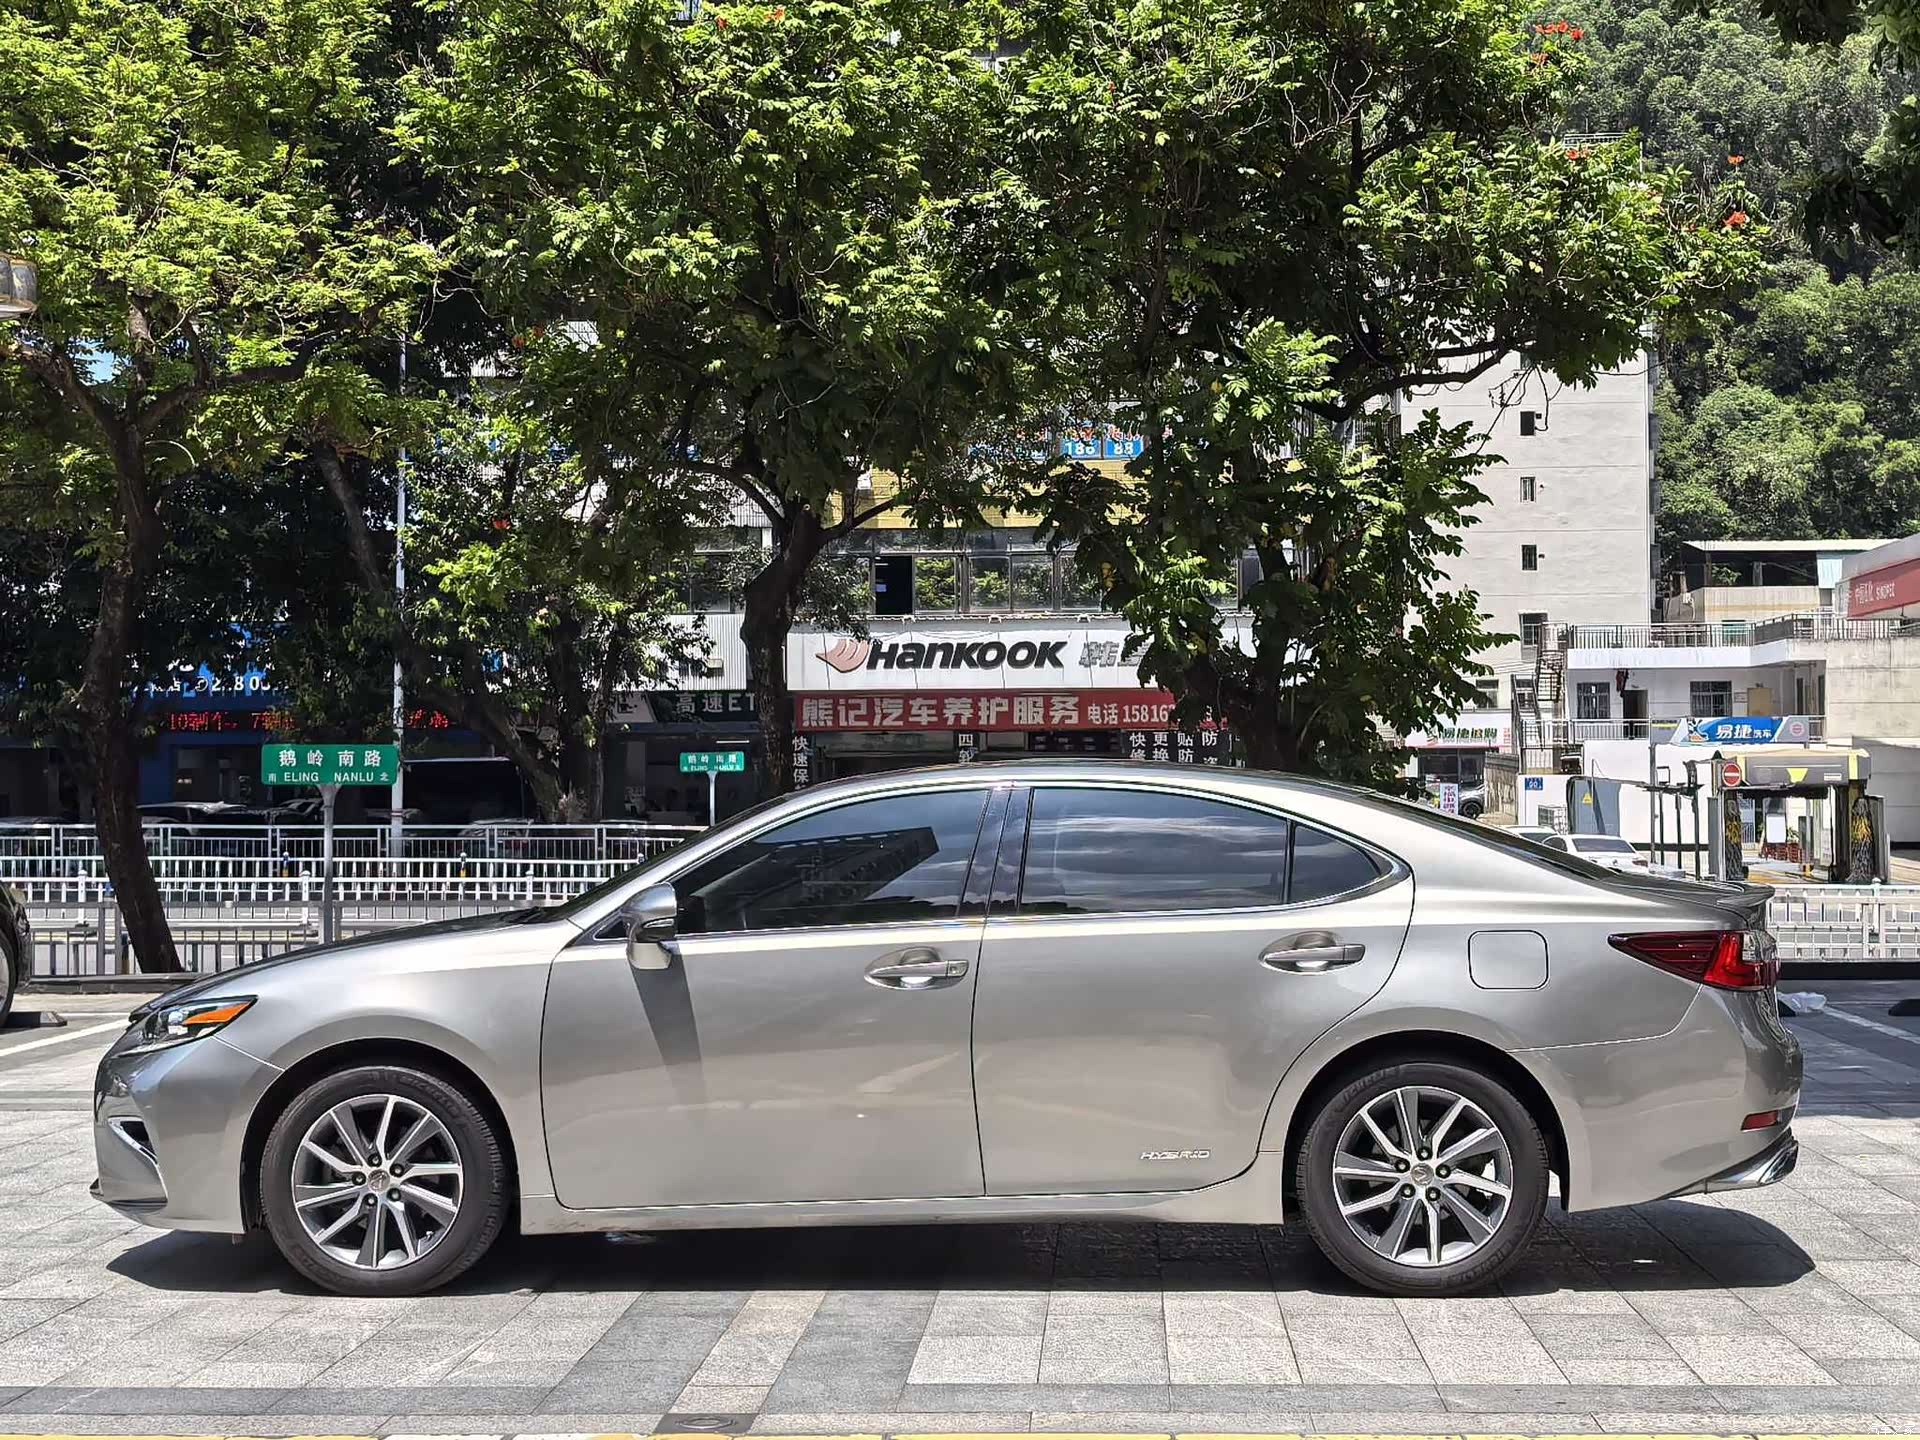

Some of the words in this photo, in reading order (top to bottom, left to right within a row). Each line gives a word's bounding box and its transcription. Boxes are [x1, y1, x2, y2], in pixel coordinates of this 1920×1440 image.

[802, 697, 1078, 727] 熊记汽车养护服务
[1087, 703, 1118, 724] 电话
[279, 749, 381, 767] 鹅岭南路
[792, 736, 809, 789] 快速保
[284, 772, 319, 782] ELING
[334, 772, 374, 782] NANLU
[1140, 1150, 1210, 1160] HYBRID
